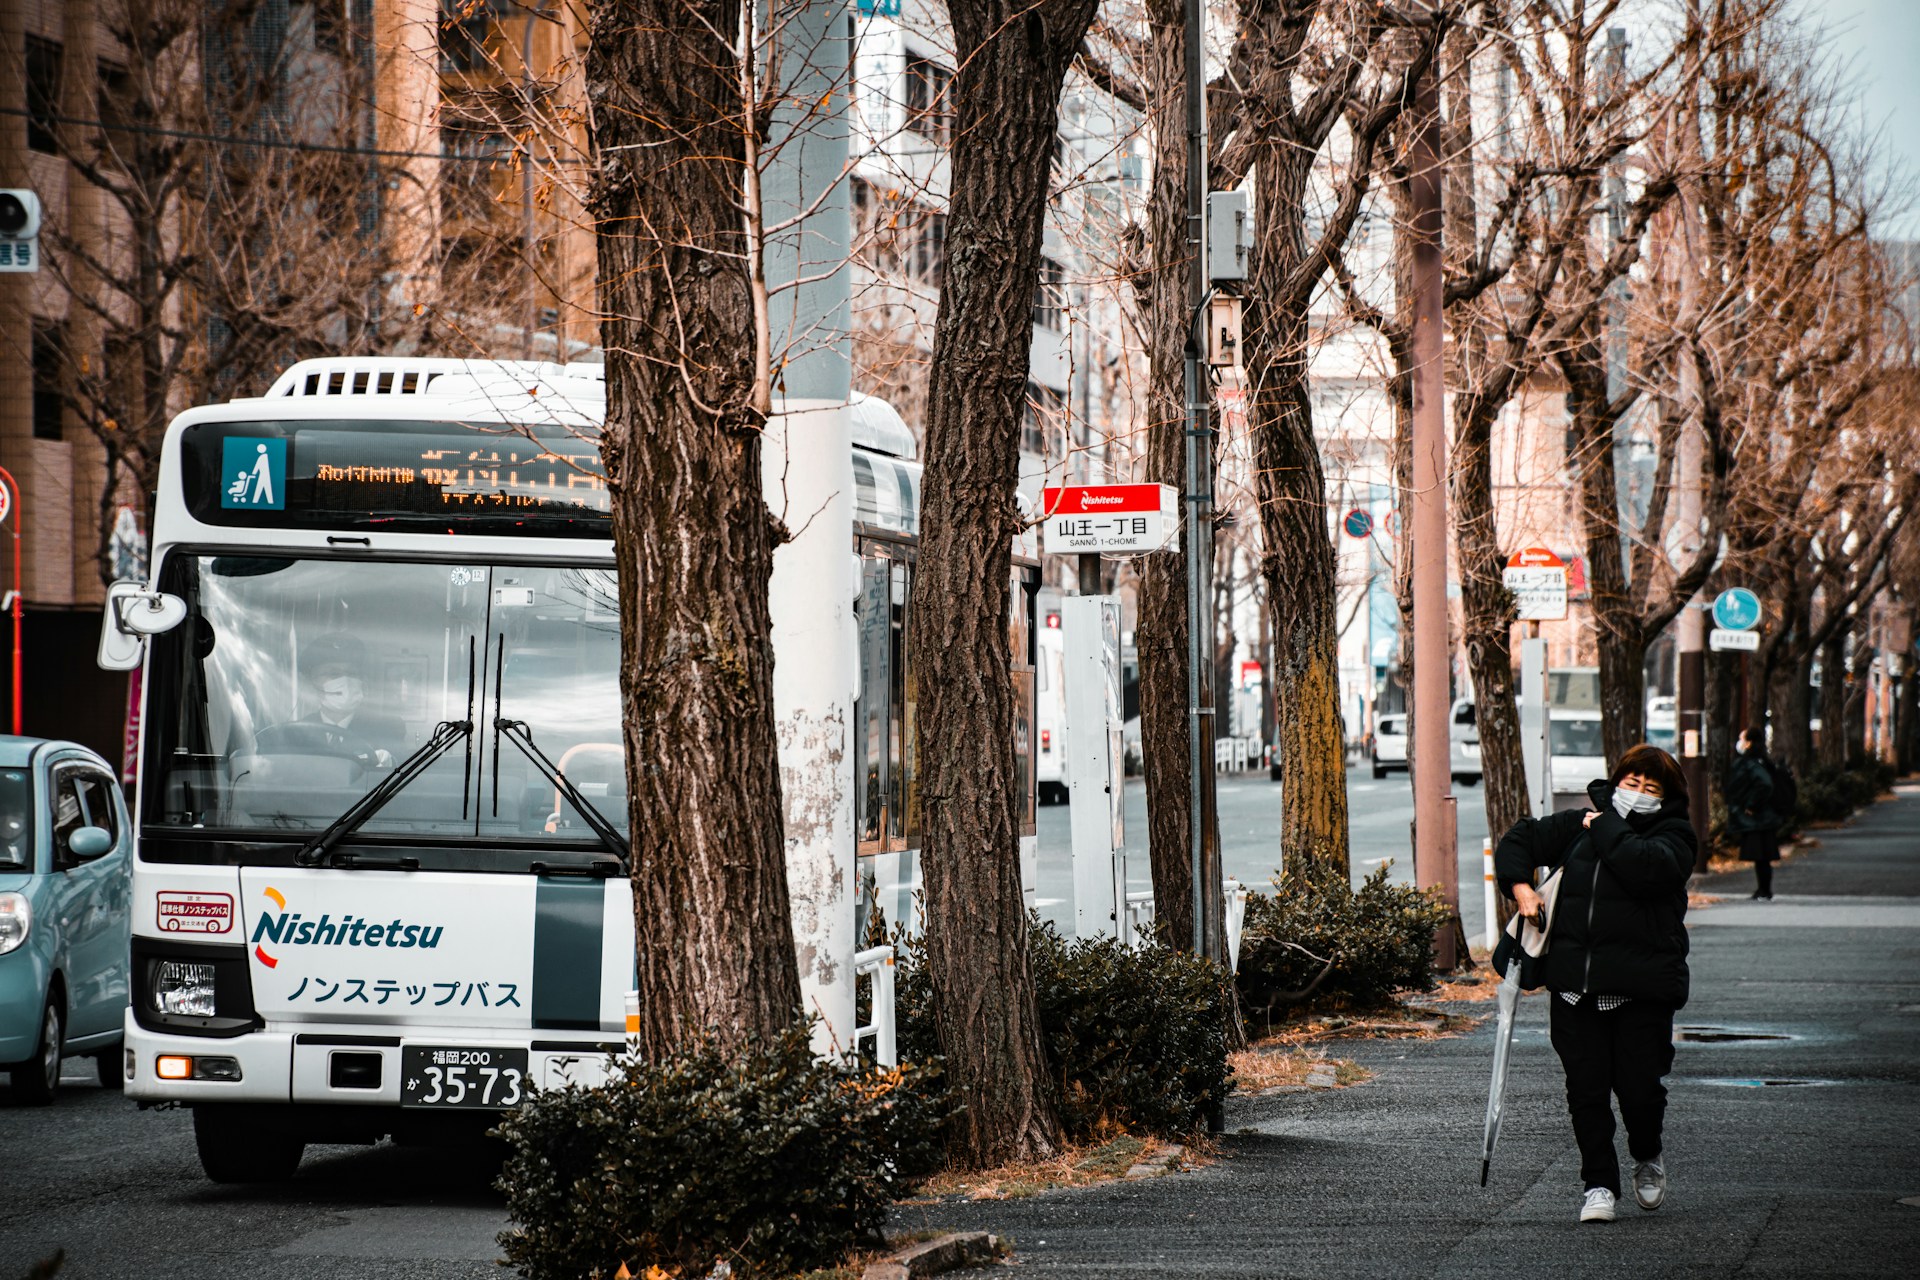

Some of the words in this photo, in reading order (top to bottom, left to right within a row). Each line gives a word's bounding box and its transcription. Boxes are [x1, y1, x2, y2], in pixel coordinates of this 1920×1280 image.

[1081, 493, 1124, 506] Nishitetsu
[1059, 517, 1146, 536] 山王一丁目
[1100, 537, 1138, 546] 1-CHOME
[251, 911, 444, 949] Nishitetsu
[287, 977, 521, 1008] ノンステップバス
[422, 1066, 522, 1106] 35-73
